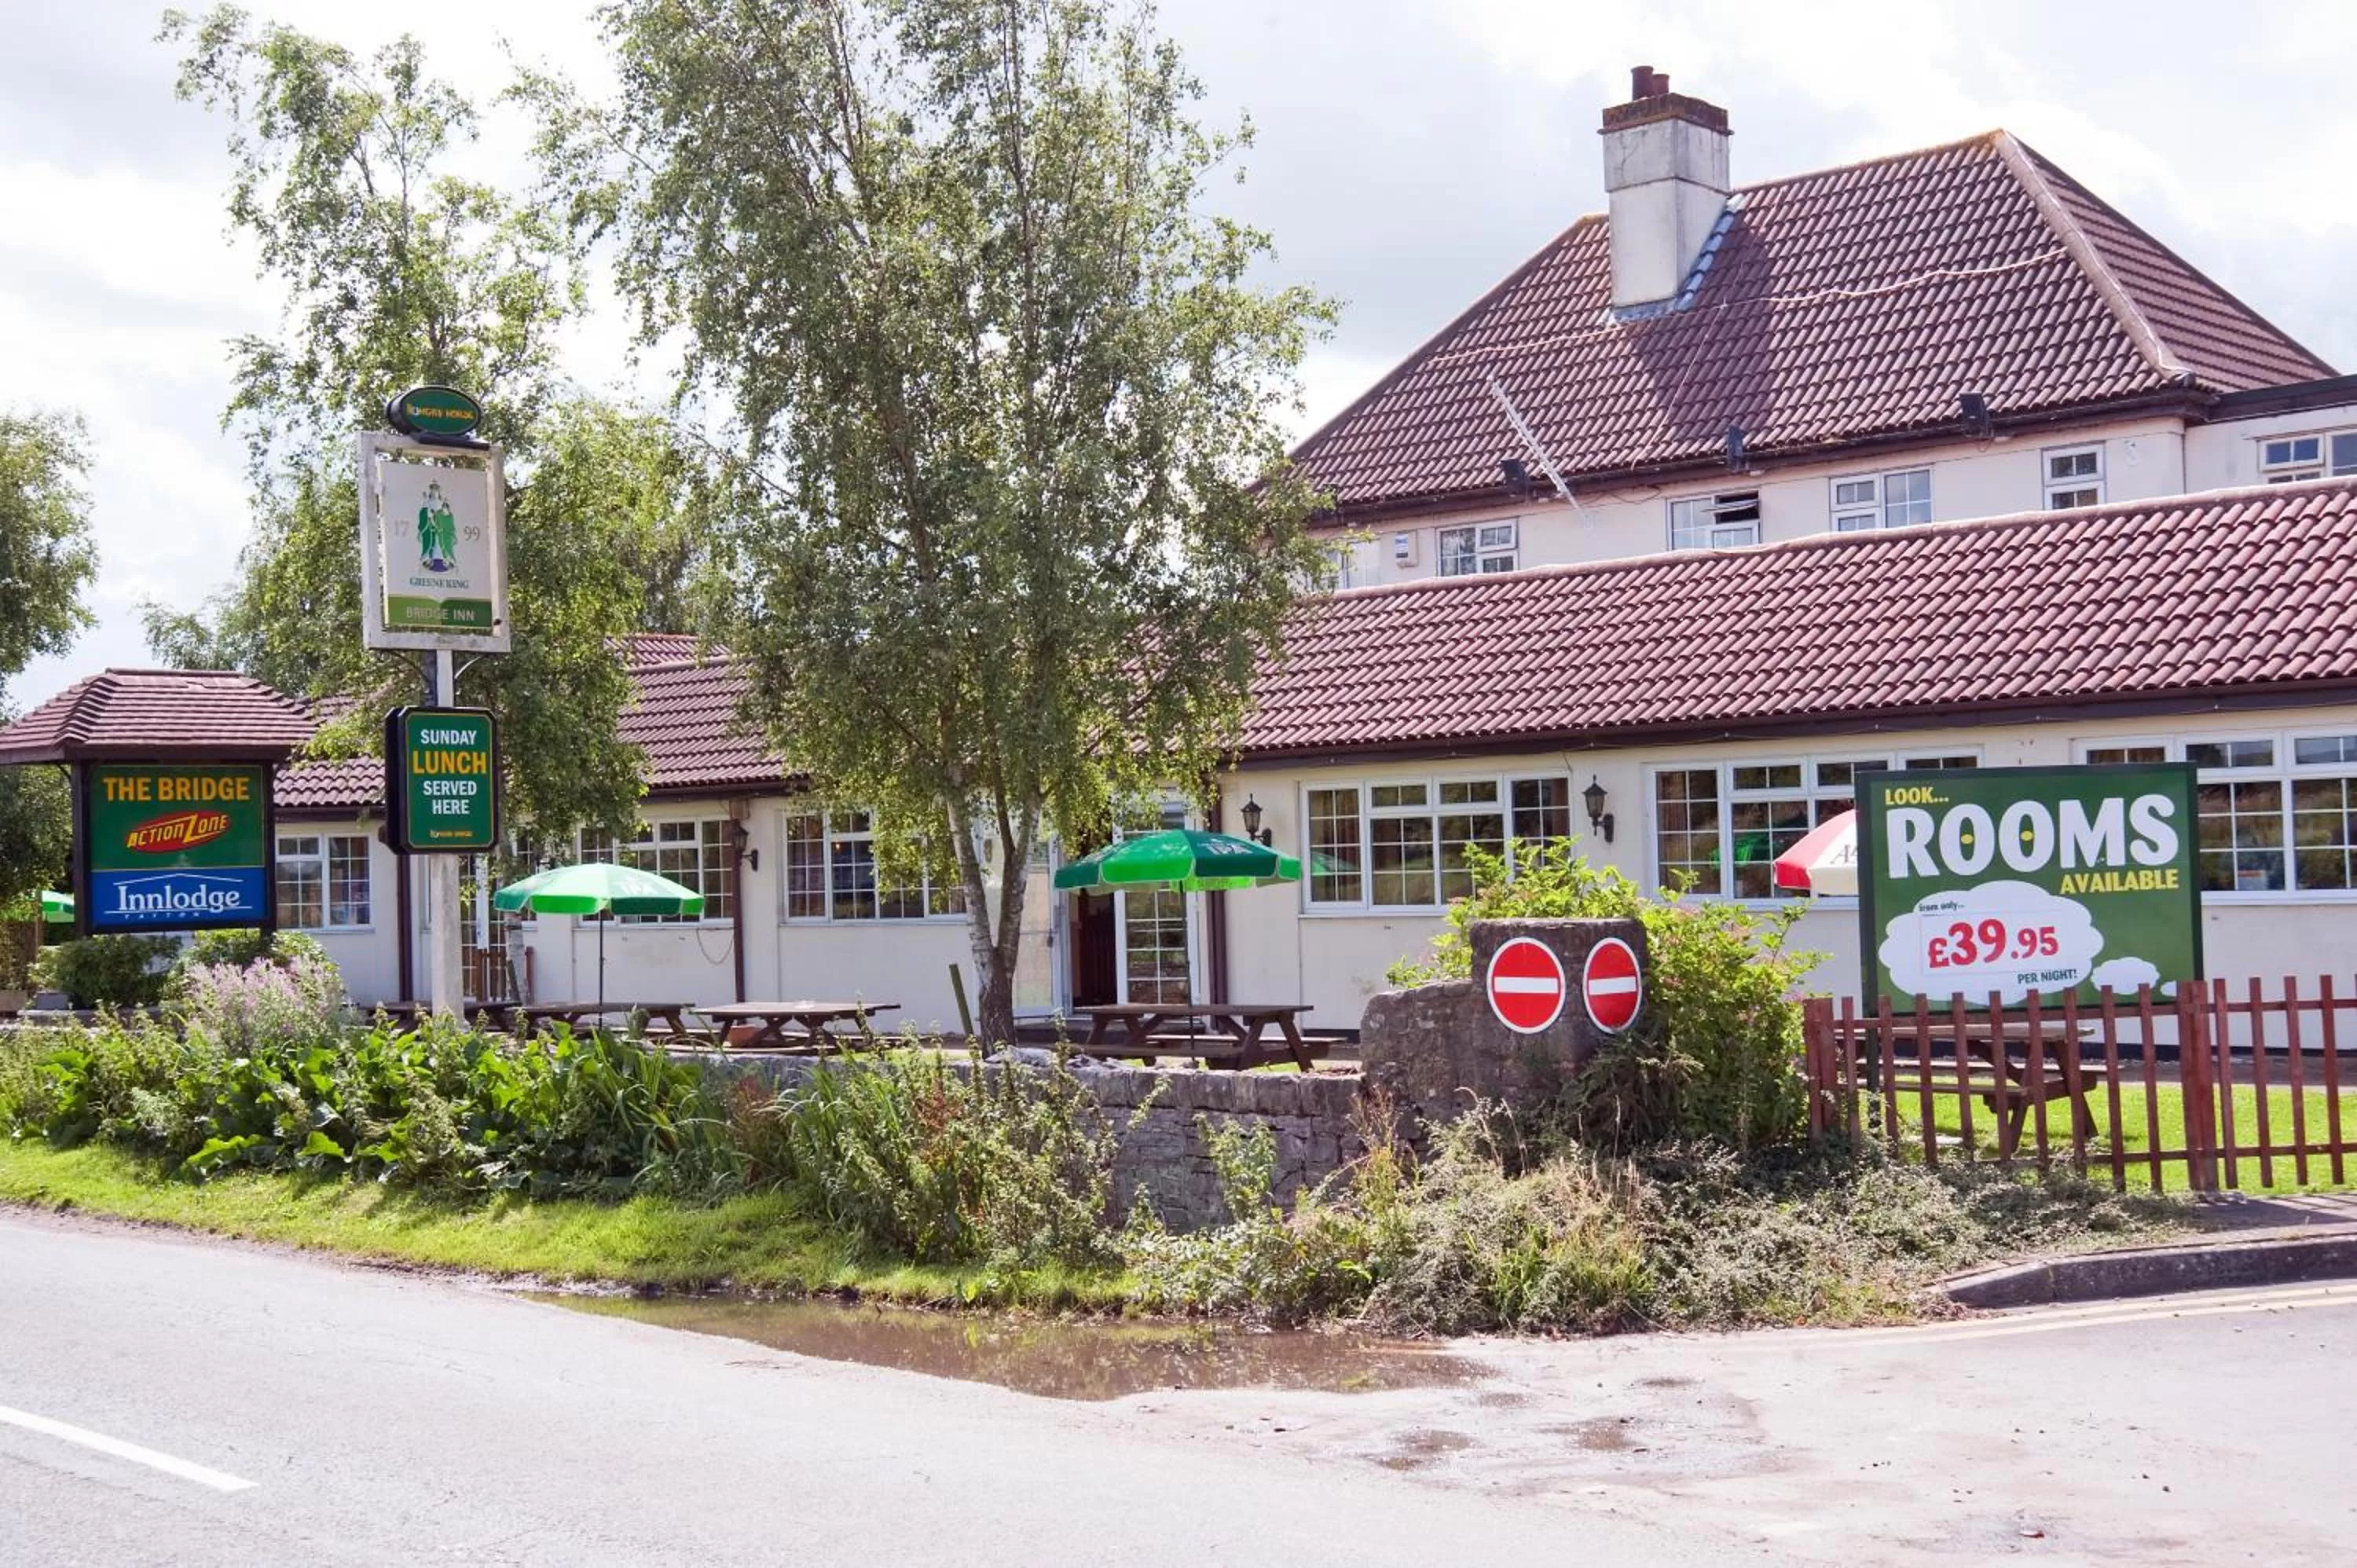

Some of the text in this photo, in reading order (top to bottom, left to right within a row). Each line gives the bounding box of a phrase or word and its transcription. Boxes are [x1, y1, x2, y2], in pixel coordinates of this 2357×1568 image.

[394, 519, 480, 540] 17 99
[406, 606, 475, 621] BRIDGE INN
[420, 729, 477, 745] SUNDAY
[412, 750, 487, 775] LUNCH
[103, 777, 250, 801] THE BRIDGE
[423, 780, 478, 796] SERVED
[1886, 787, 1949, 805] LOOK...
[432, 799, 471, 815] HERE
[1886, 793, 2179, 878] ROOMS
[2059, 869, 2179, 895] AVAILABLE
[118, 884, 240, 913] Innlodge
[1928, 918, 2059, 968] £39.95
[2018, 969, 2078, 984] PER NIGHT!
